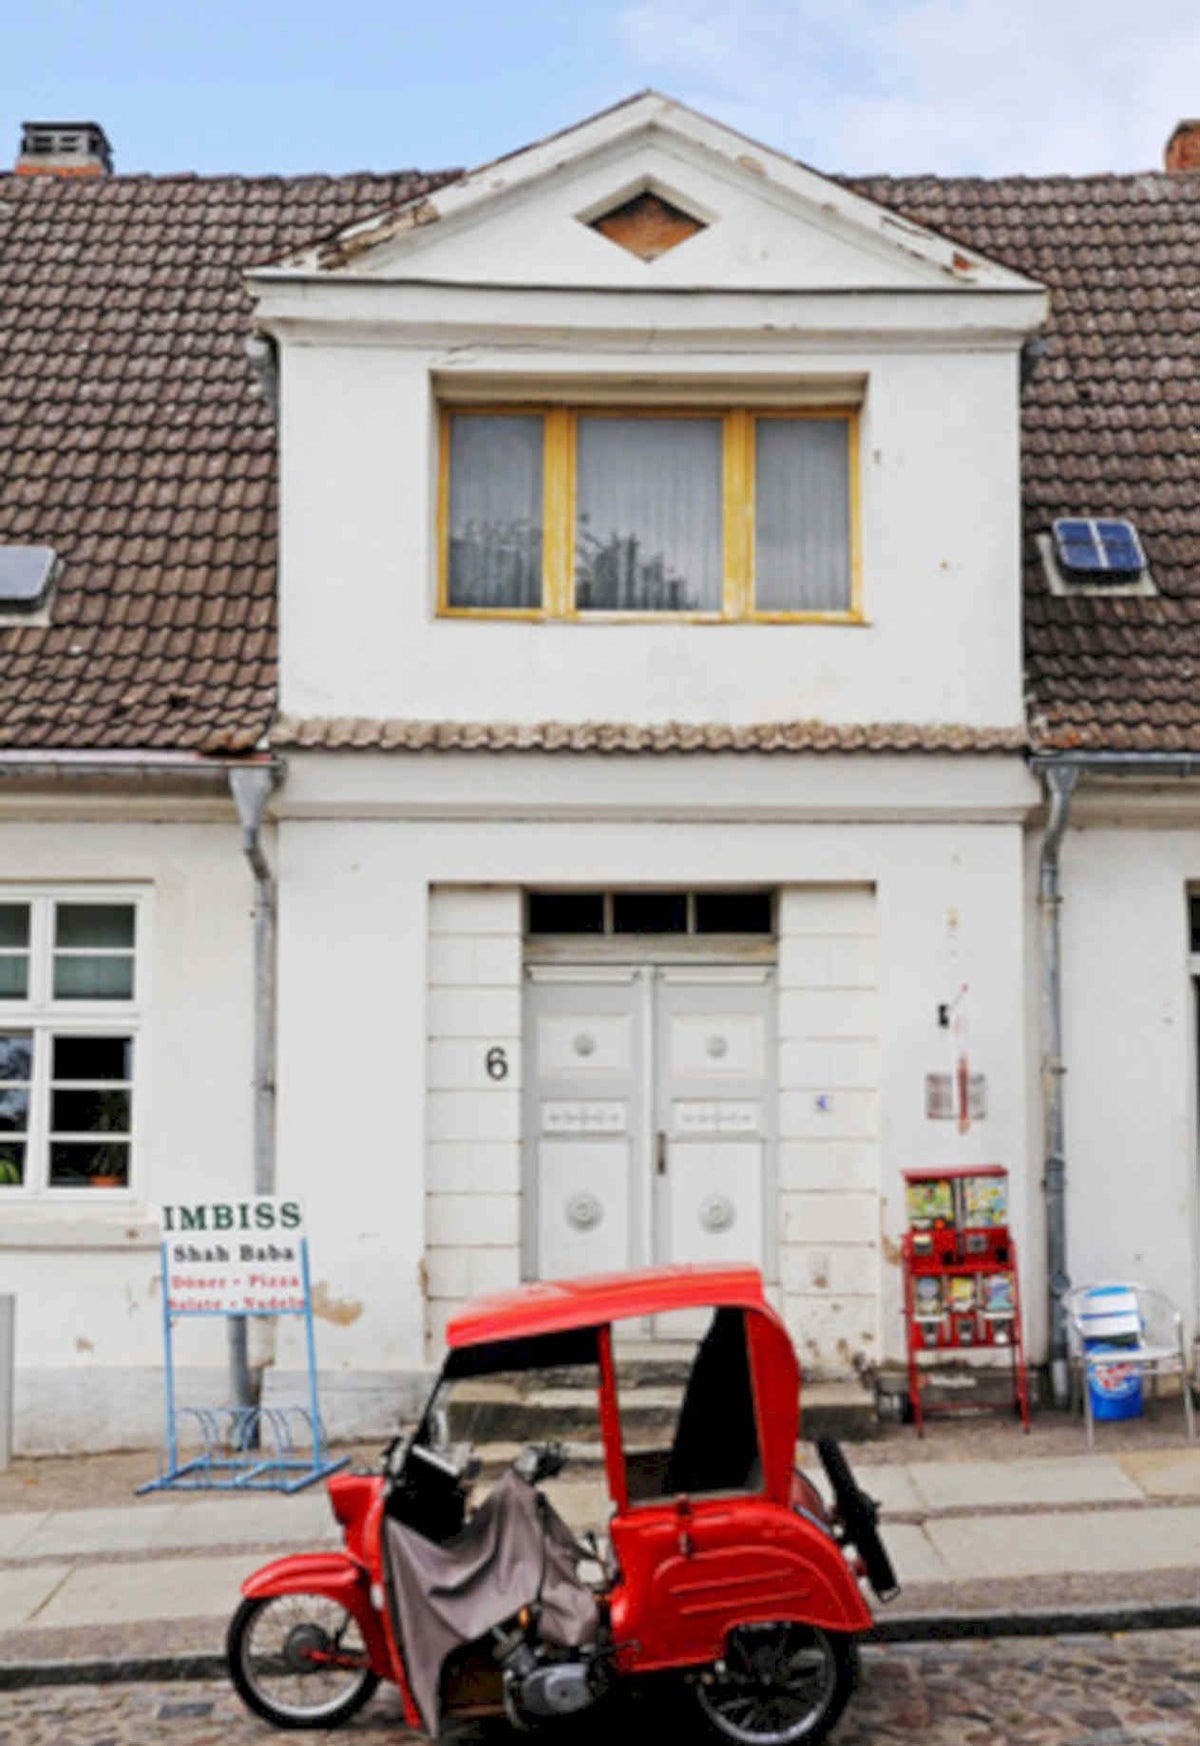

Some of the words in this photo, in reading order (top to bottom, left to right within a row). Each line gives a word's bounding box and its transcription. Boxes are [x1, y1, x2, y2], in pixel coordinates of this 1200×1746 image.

[486, 1046, 508, 1081] 6
[163, 1202, 302, 1231] IMBISS
[174, 1244, 230, 1262] Shah
[239, 1244, 294, 1262] Baba
[249, 1274, 299, 1288] Pizza
